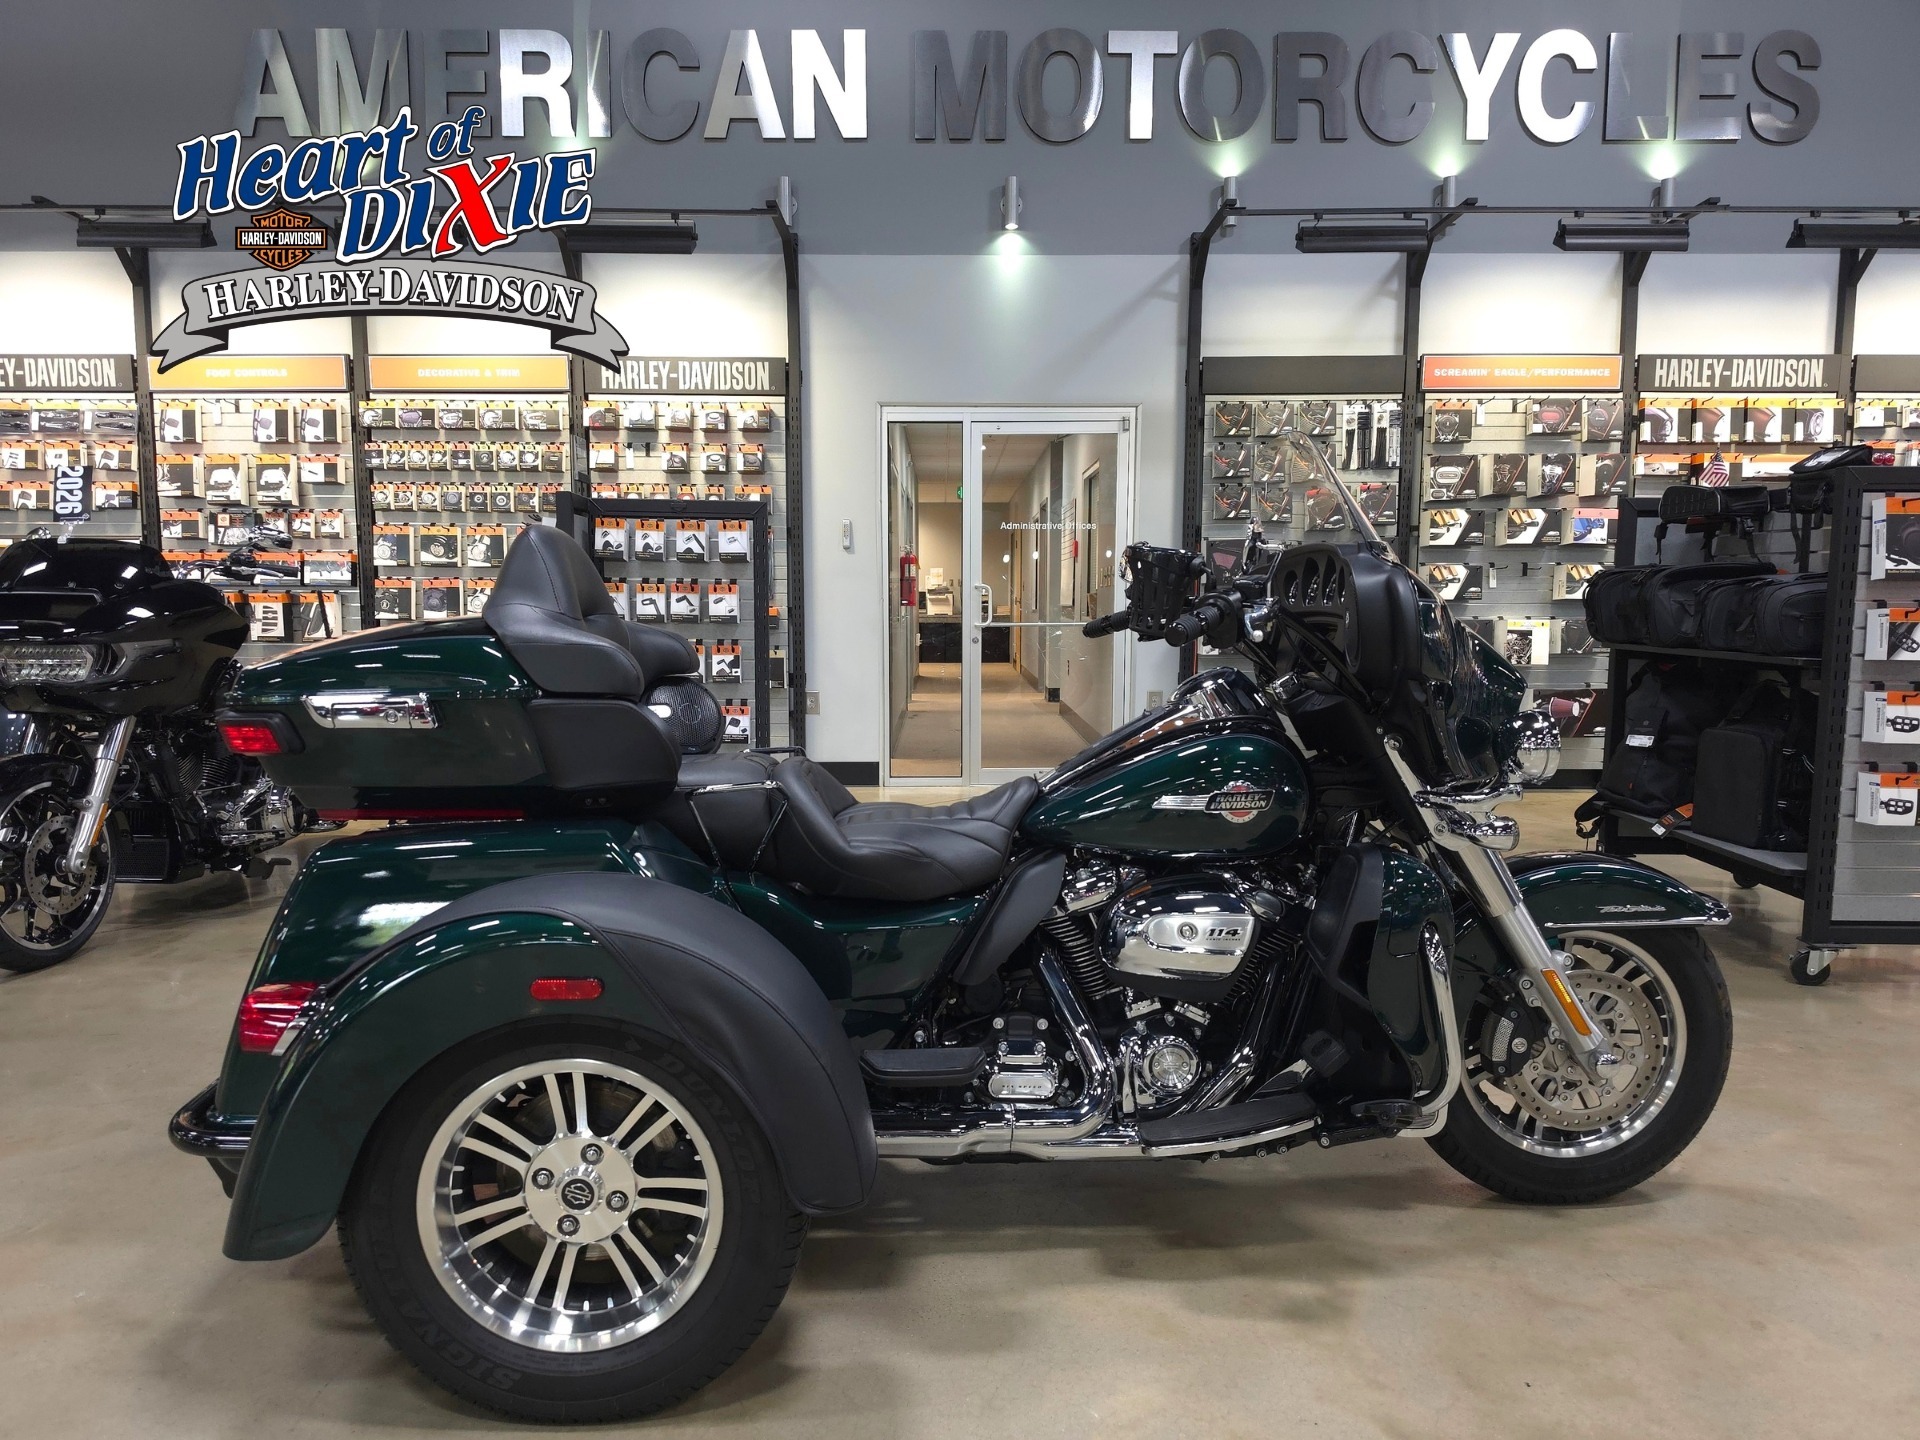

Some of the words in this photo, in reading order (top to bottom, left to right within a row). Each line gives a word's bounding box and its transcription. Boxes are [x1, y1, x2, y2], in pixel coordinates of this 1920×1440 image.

[235, 27, 868, 141] AMERICAN
[911, 28, 1823, 145] MOTORCYCLES
[206, 368, 232, 377] FOOT
[234, 368, 288, 377] CONTROLS
[417, 368, 481, 377] DECORATIVE
[484, 368, 492, 377] &
[495, 368, 521, 377] TRIM
[601, 360, 770, 391] HARLEY-DAVIDSON
[1434, 367, 1490, 377] SCREAMIN'
[1494, 367, 1611, 378] EAGLE/PERFORMANCE
[1655, 357, 1824, 388] HARLEY-DAVIDSON
[55, 465, 84, 515] 2026
[1000, 521, 1062, 530] Administrative
[1065, 521, 1097, 530] Offices
[1208, 928, 1241, 937] 114
